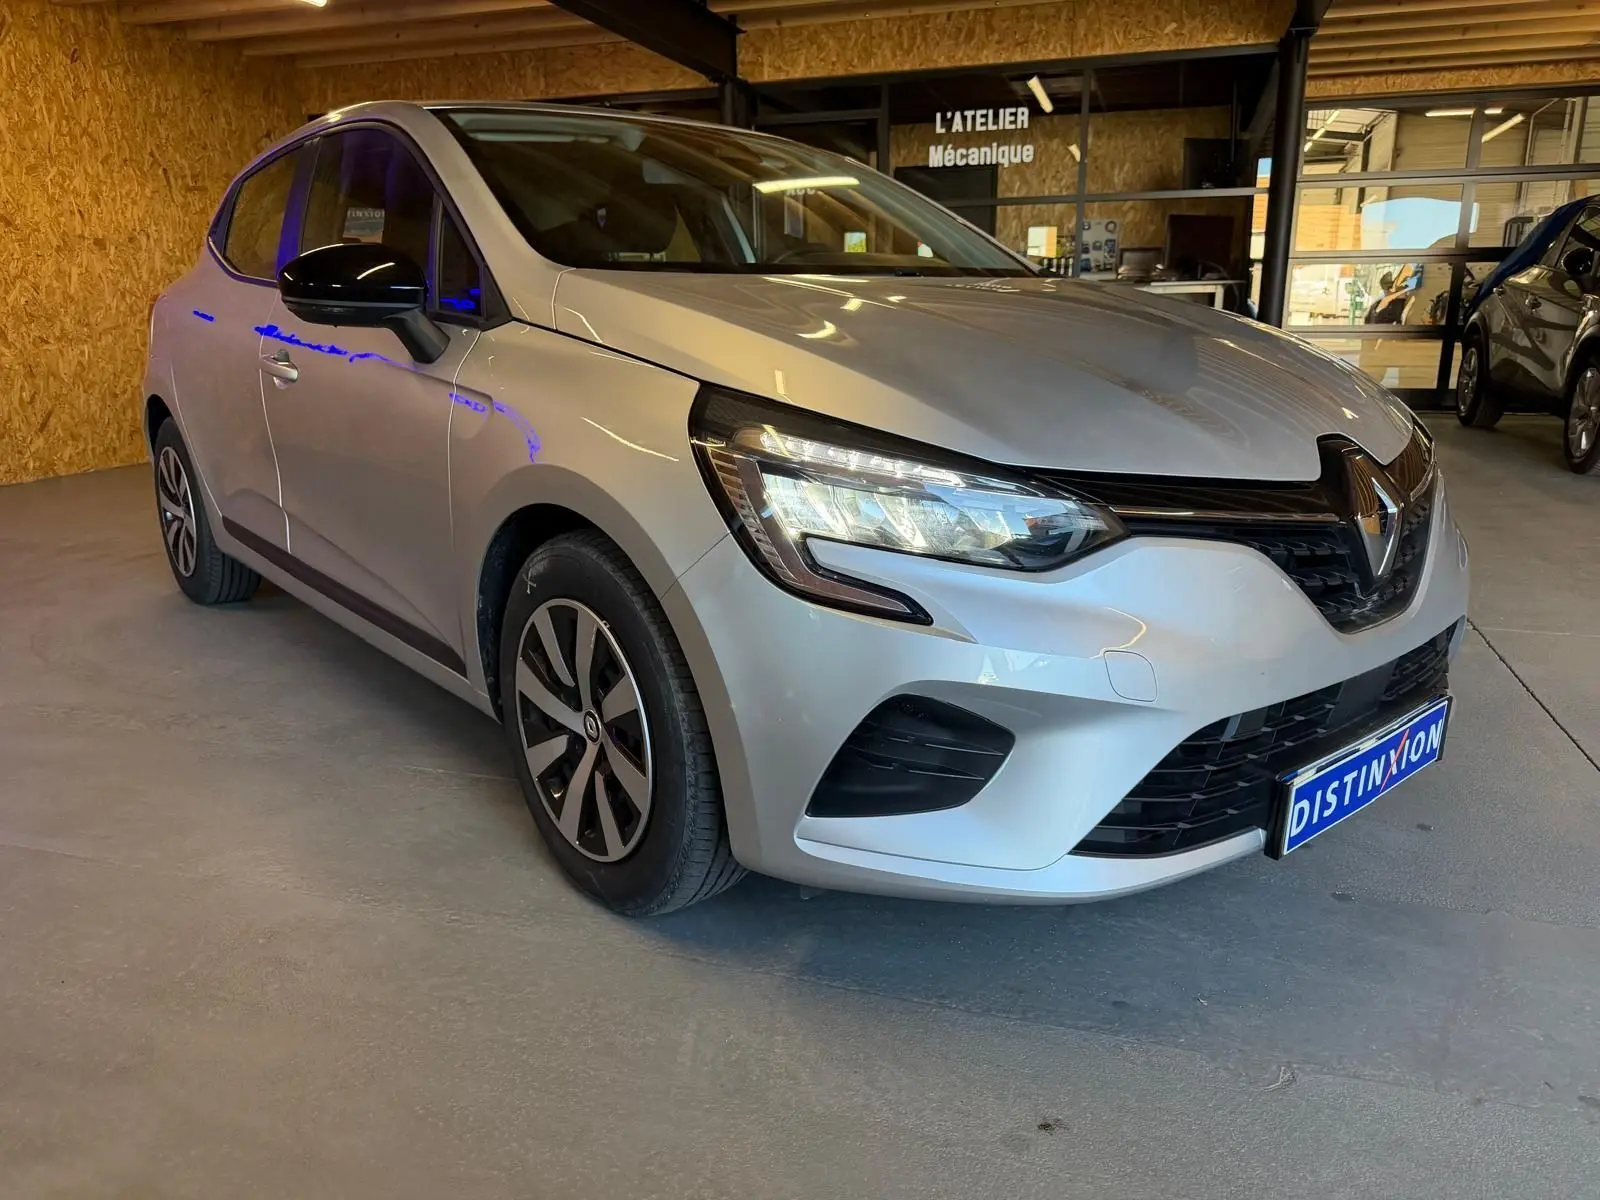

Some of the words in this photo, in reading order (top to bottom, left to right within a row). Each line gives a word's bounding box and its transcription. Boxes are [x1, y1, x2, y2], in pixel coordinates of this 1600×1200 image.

[935, 107, 1029, 134] L'ATELIER
[928, 142, 1034, 168] Mécanique
[1290, 718, 1443, 838] DISTINXION
